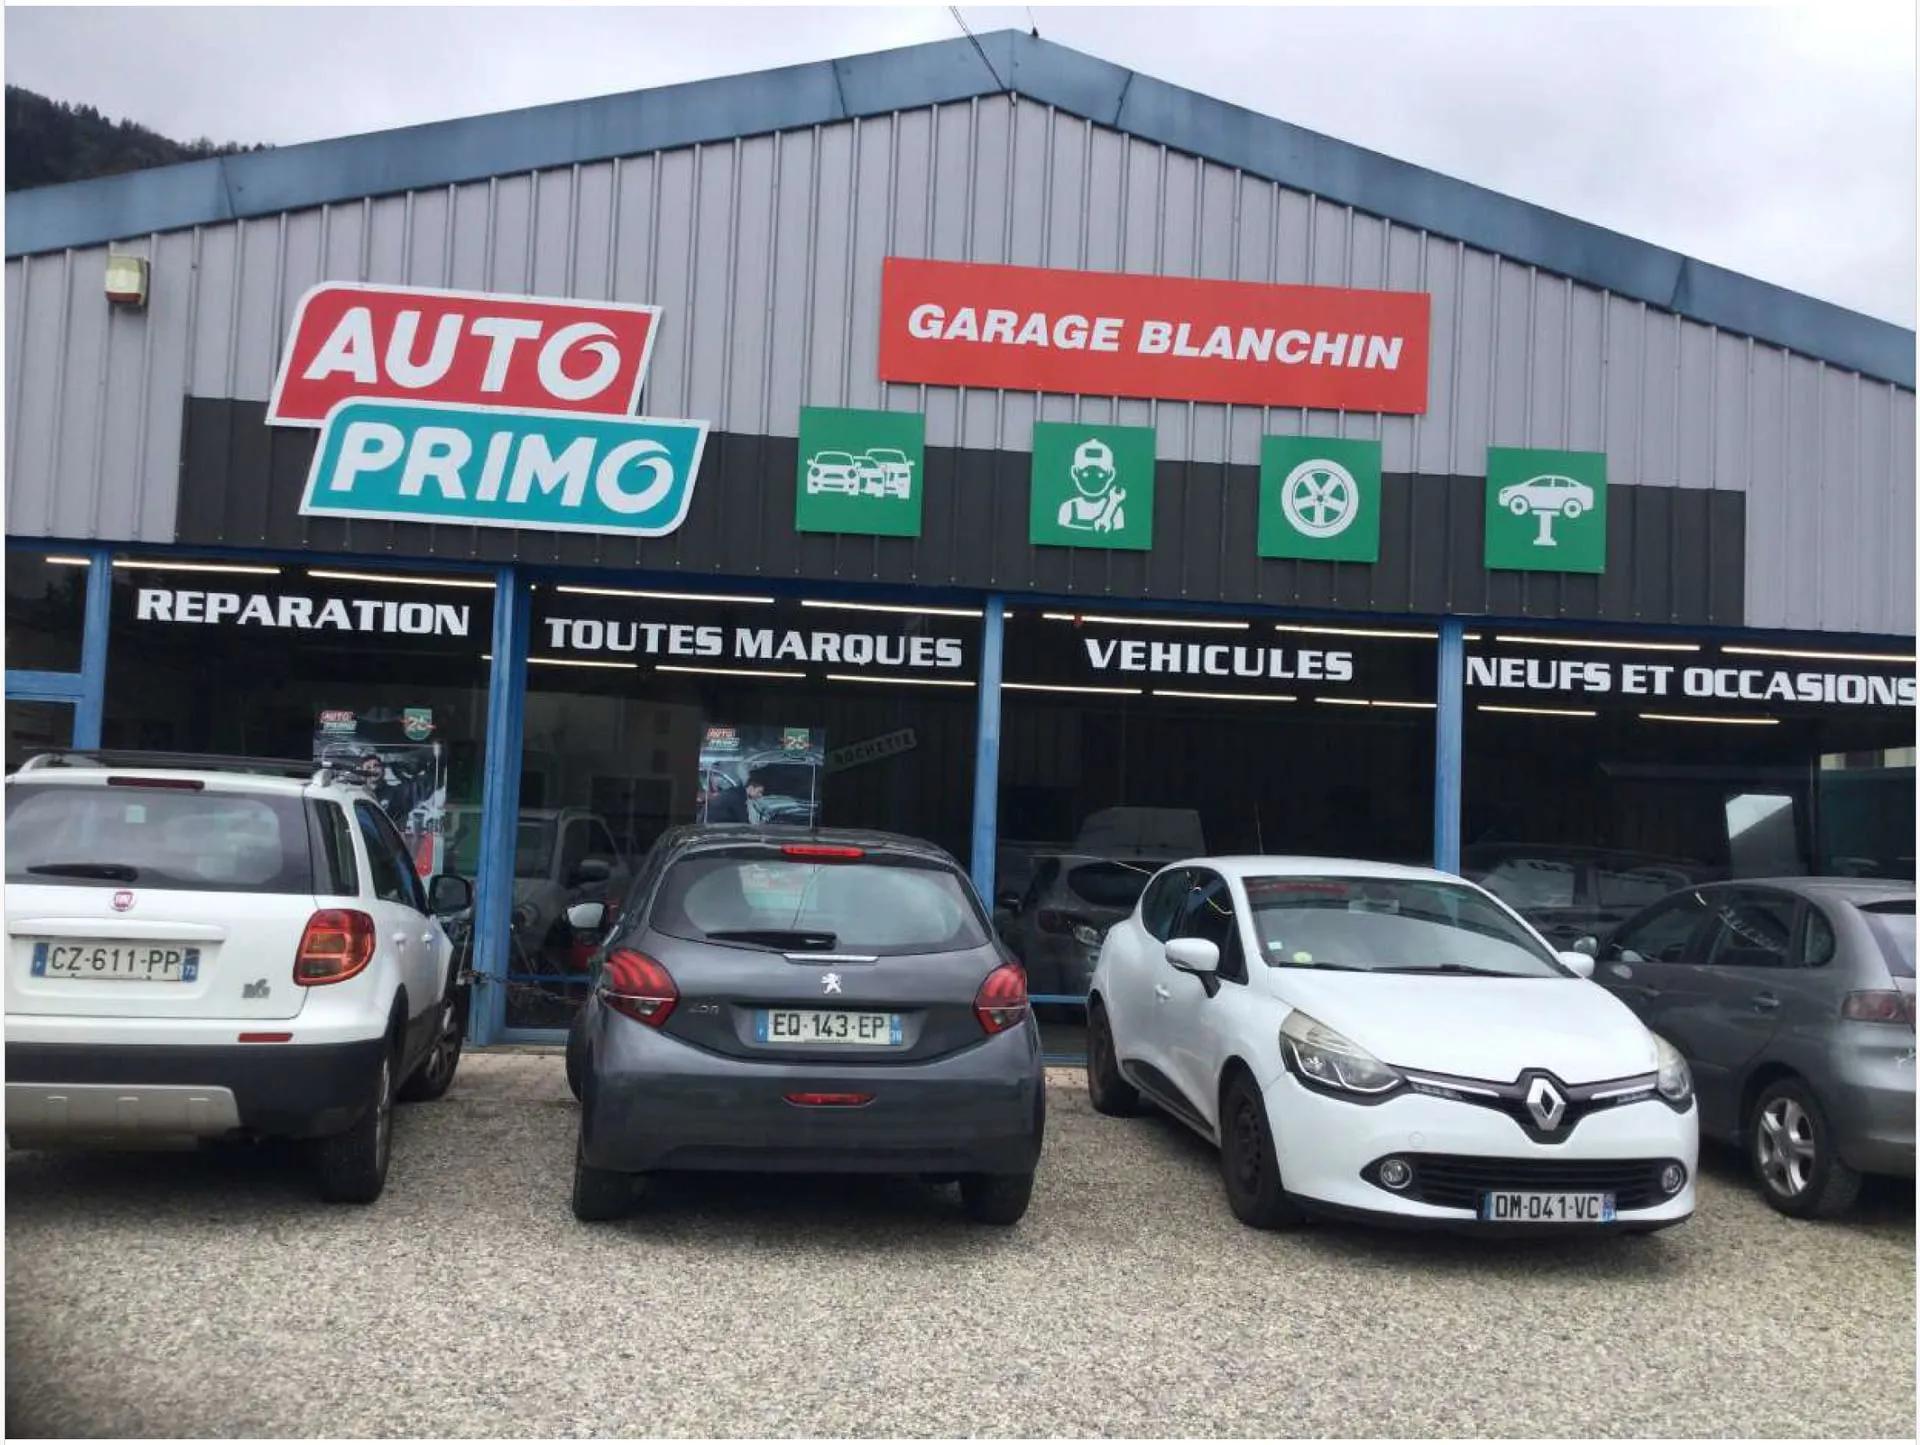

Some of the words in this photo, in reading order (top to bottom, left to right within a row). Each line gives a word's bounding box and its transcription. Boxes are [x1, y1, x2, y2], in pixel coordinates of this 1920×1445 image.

[303, 307, 621, 400] AUTO
[908, 304, 1126, 351] GARAGE
[1137, 320, 1403, 370] BLANCHIN
[330, 421, 674, 514] PRIMO
[137, 589, 470, 636] REPARATION
[545, 617, 723, 656] TOUTES
[734, 627, 962, 667] MARQUES
[1085, 638, 1353, 681] VEHICULES
[1466, 656, 1610, 692] NEUFS
[1622, 664, 1674, 694] ET
[1683, 668, 1916, 706] OCCASIONS
